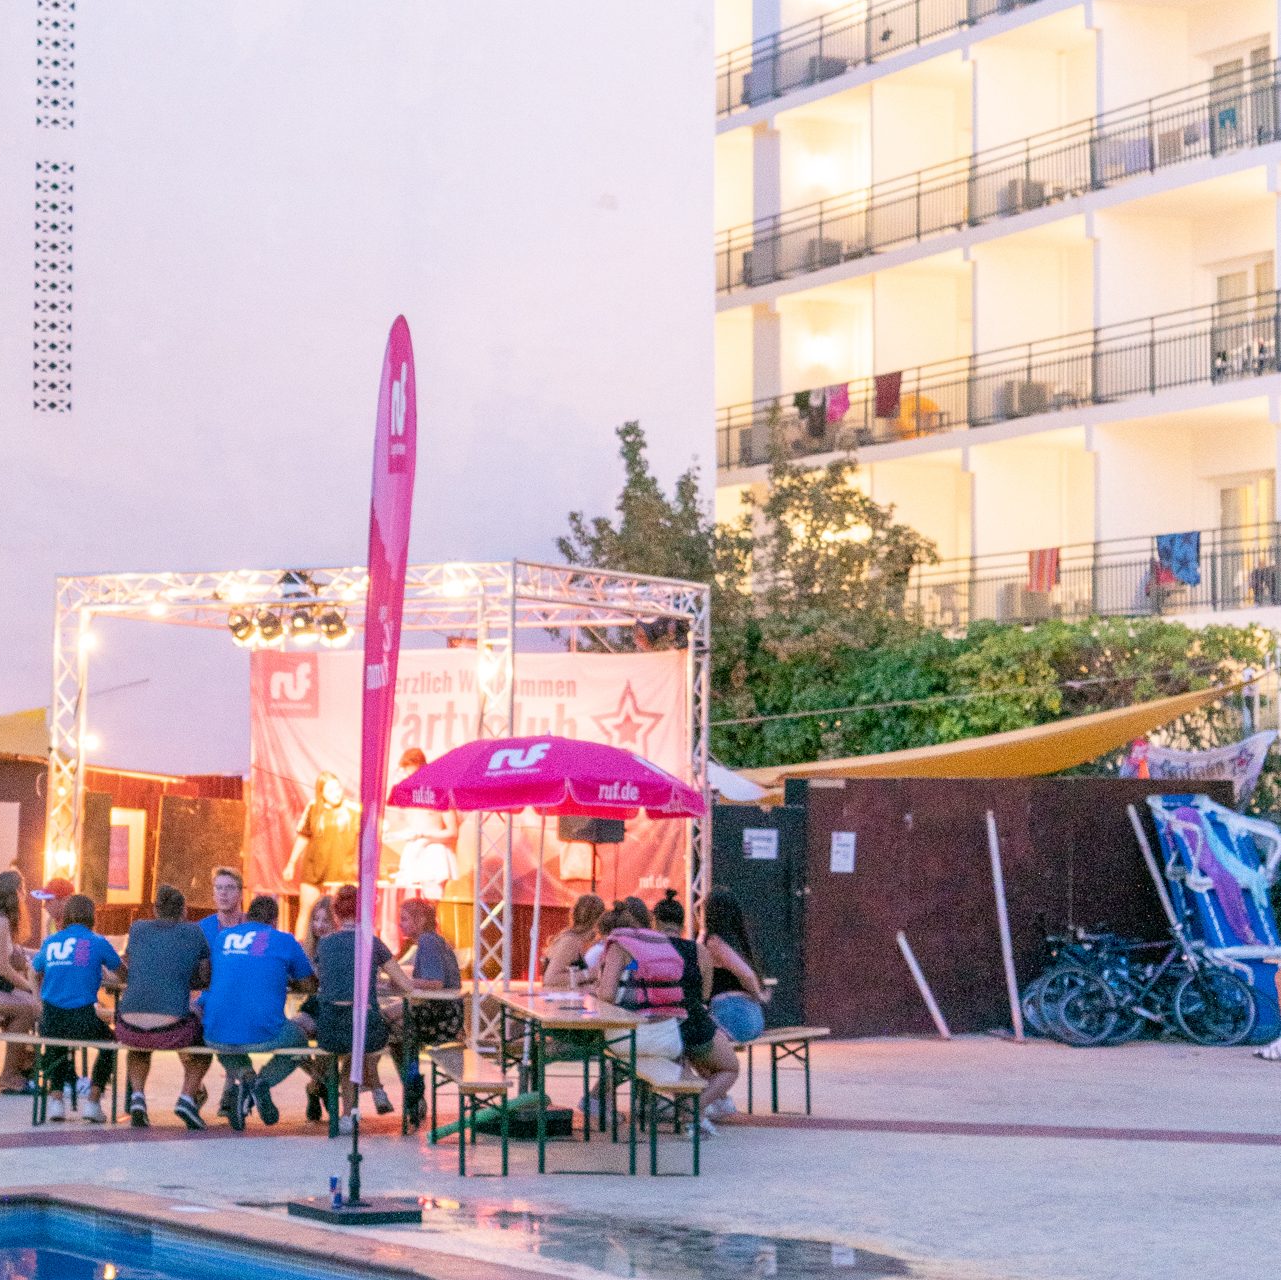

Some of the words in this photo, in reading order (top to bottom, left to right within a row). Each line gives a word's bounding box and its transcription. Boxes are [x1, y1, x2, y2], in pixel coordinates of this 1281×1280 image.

[270, 662, 312, 700] ruf
[395, 670, 453, 695] erzlich
[485, 742, 551, 770] ruf
[598, 782, 640, 802] ruf.de
[46, 936, 77, 962] ruf
[223, 930, 257, 950] ruf
